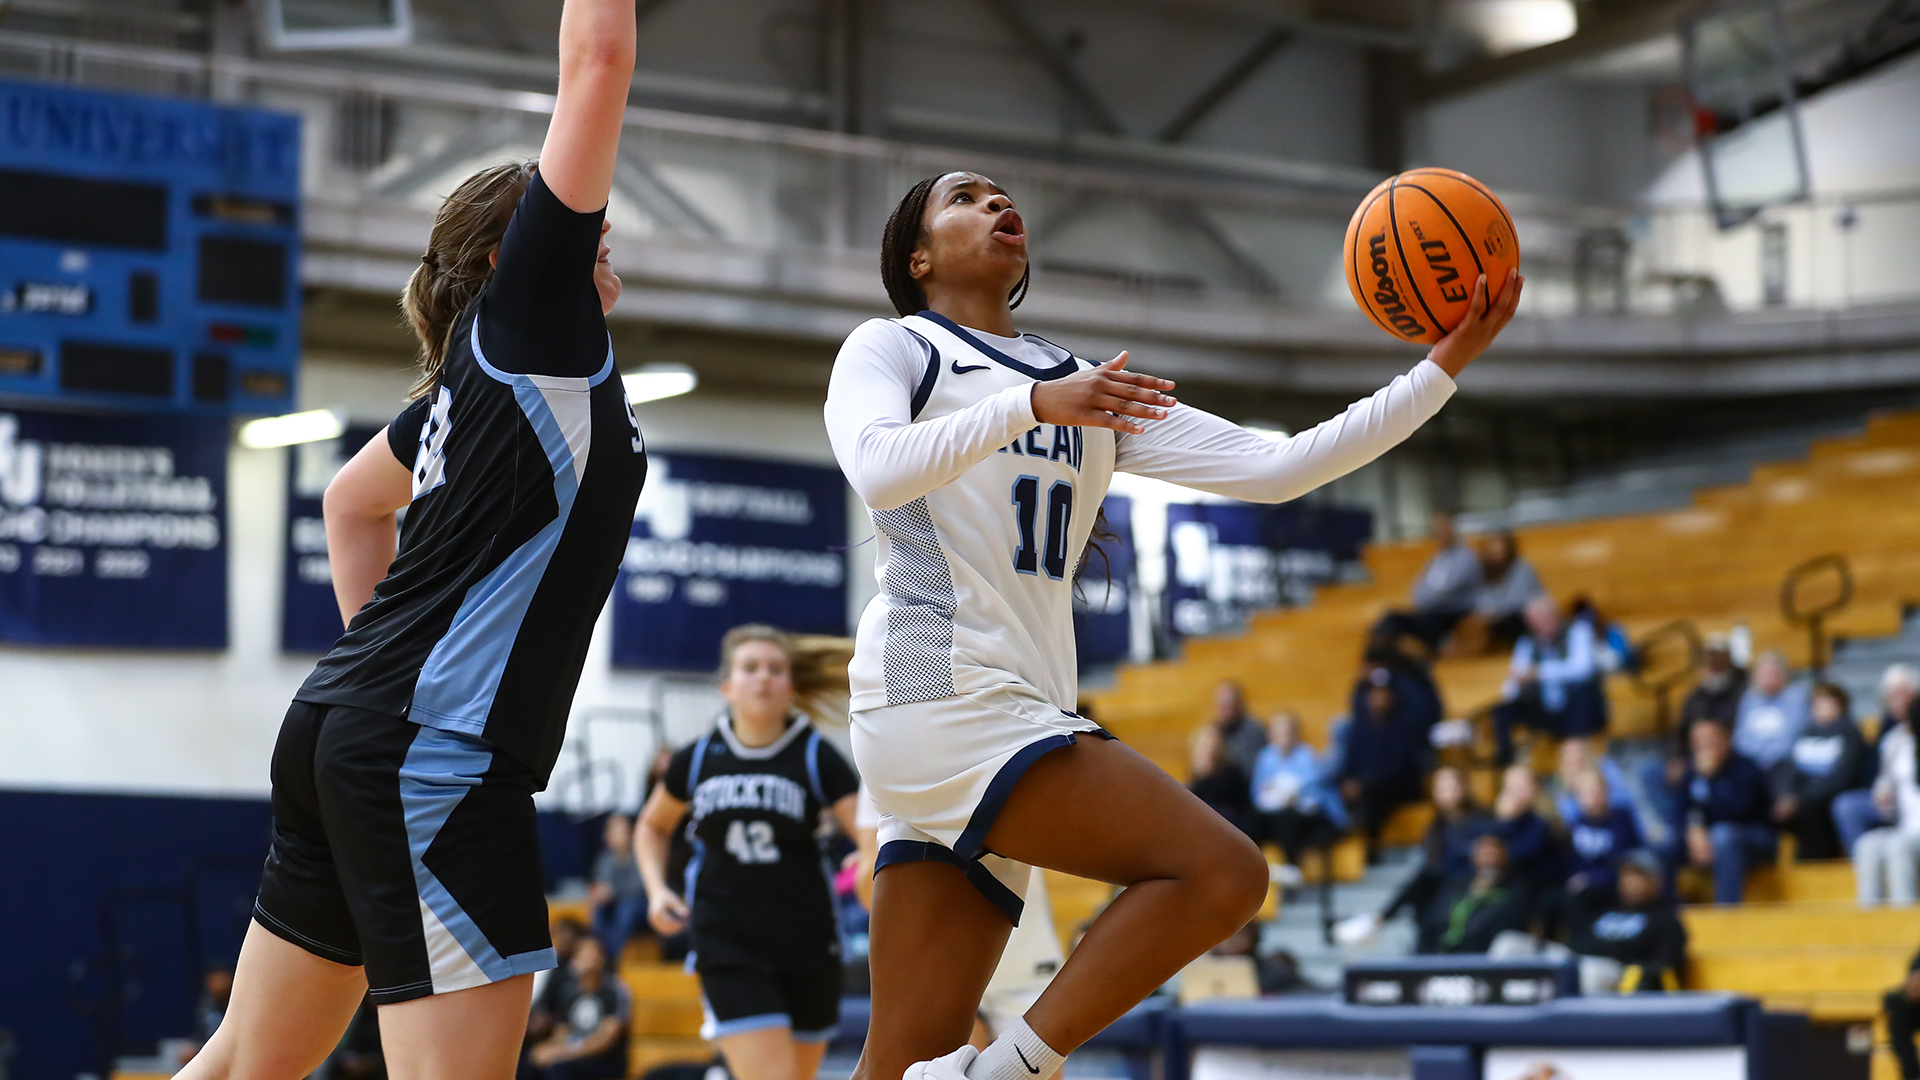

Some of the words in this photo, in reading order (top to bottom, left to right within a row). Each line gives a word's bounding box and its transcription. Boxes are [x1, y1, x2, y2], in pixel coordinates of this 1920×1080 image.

[1369, 231, 1427, 339] Wilson
[1420, 240, 1468, 303] EVO
[1011, 473, 1073, 583] 10
[692, 773, 806, 824] STOCKTON
[724, 819, 782, 865] 42
